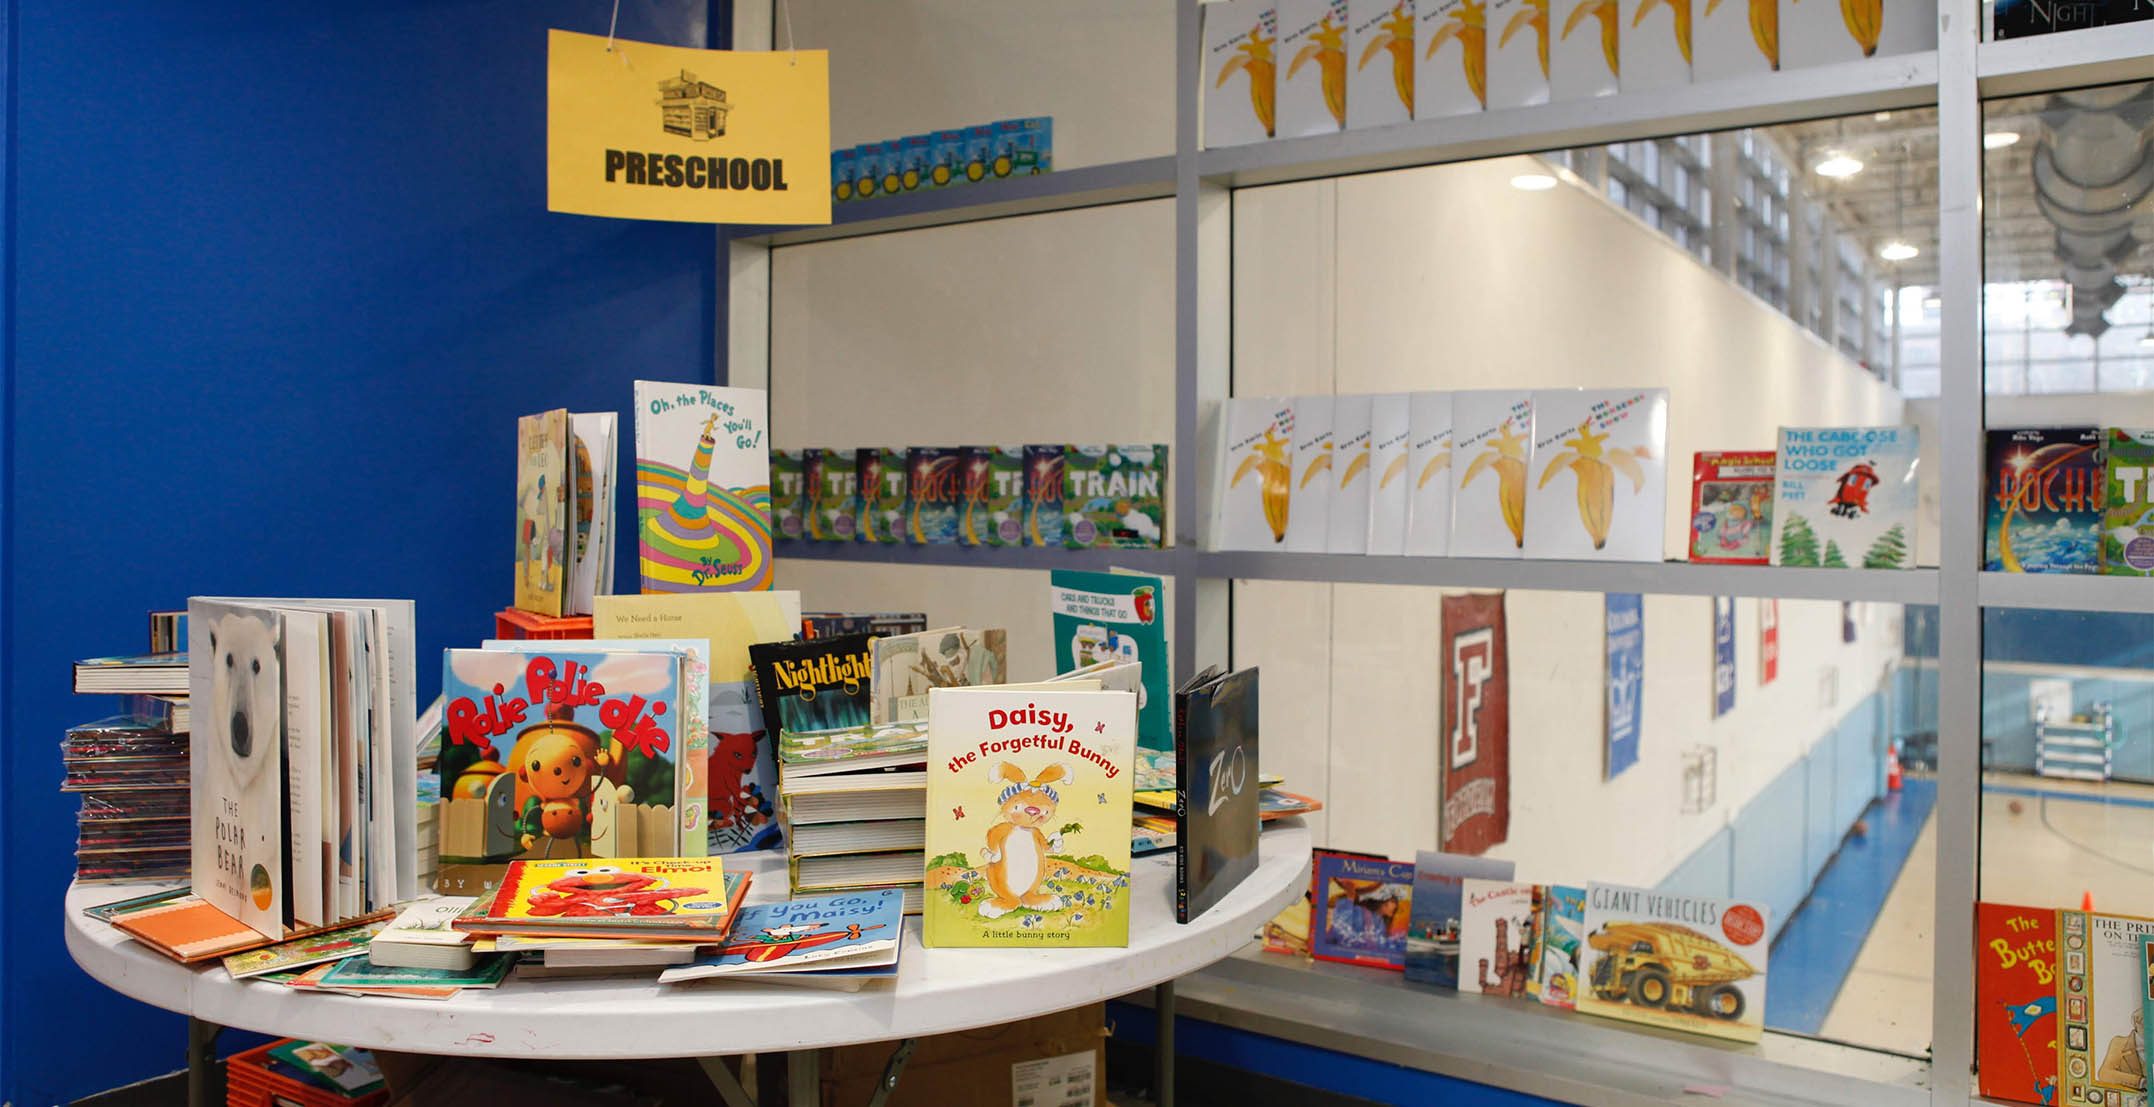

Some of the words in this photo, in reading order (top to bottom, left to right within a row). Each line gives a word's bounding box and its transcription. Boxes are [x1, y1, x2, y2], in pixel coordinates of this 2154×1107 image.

[605, 149, 788, 191] PRESCHOOL
[650, 399, 674, 415] Oh,
[676, 395, 697, 407] the
[699, 391, 736, 417] Places
[723, 419, 752, 433] You'll
[1785, 431, 1813, 442] THE
[736, 430, 762, 450] Go!
[1785, 445, 1828, 456] WHO
[1834, 444, 1868, 456] GOT
[1784, 459, 1838, 471] LOOSE
[1069, 471, 1159, 497] TRAIN
[691, 568, 713, 586] Dr.
[713, 558, 743, 578] Seuss
[616, 615, 629, 623] We
[631, 613, 652, 623] Need
[771, 651, 873, 702] Nightlight
[447, 683, 528, 749] Rolie
[525, 656, 606, 708] Polie
[1452, 627, 1495, 771] F
[988, 703, 1074, 733] Daisy,
[948, 749, 976, 773] the
[979, 735, 1065, 758] Forgetful
[1067, 739, 1120, 779] Bunny
[222, 797, 239, 817] THE
[215, 816, 246, 850] POLAR
[217, 844, 245, 879] BEAR
[641, 865, 712, 874] Elmo!
[789, 900, 884, 923] Maisy!
[1593, 888, 1641, 914] GIANT
[1648, 895, 1717, 926] VEHICLES
[982, 930, 989, 939] A
[992, 930, 1013, 939] little
[1016, 930, 1043, 940] bunny
[1046, 930, 1070, 940] story
[2006, 916, 2039, 933] The
[2093, 919, 2122, 930] THE
[2104, 930, 2122, 940] ON
